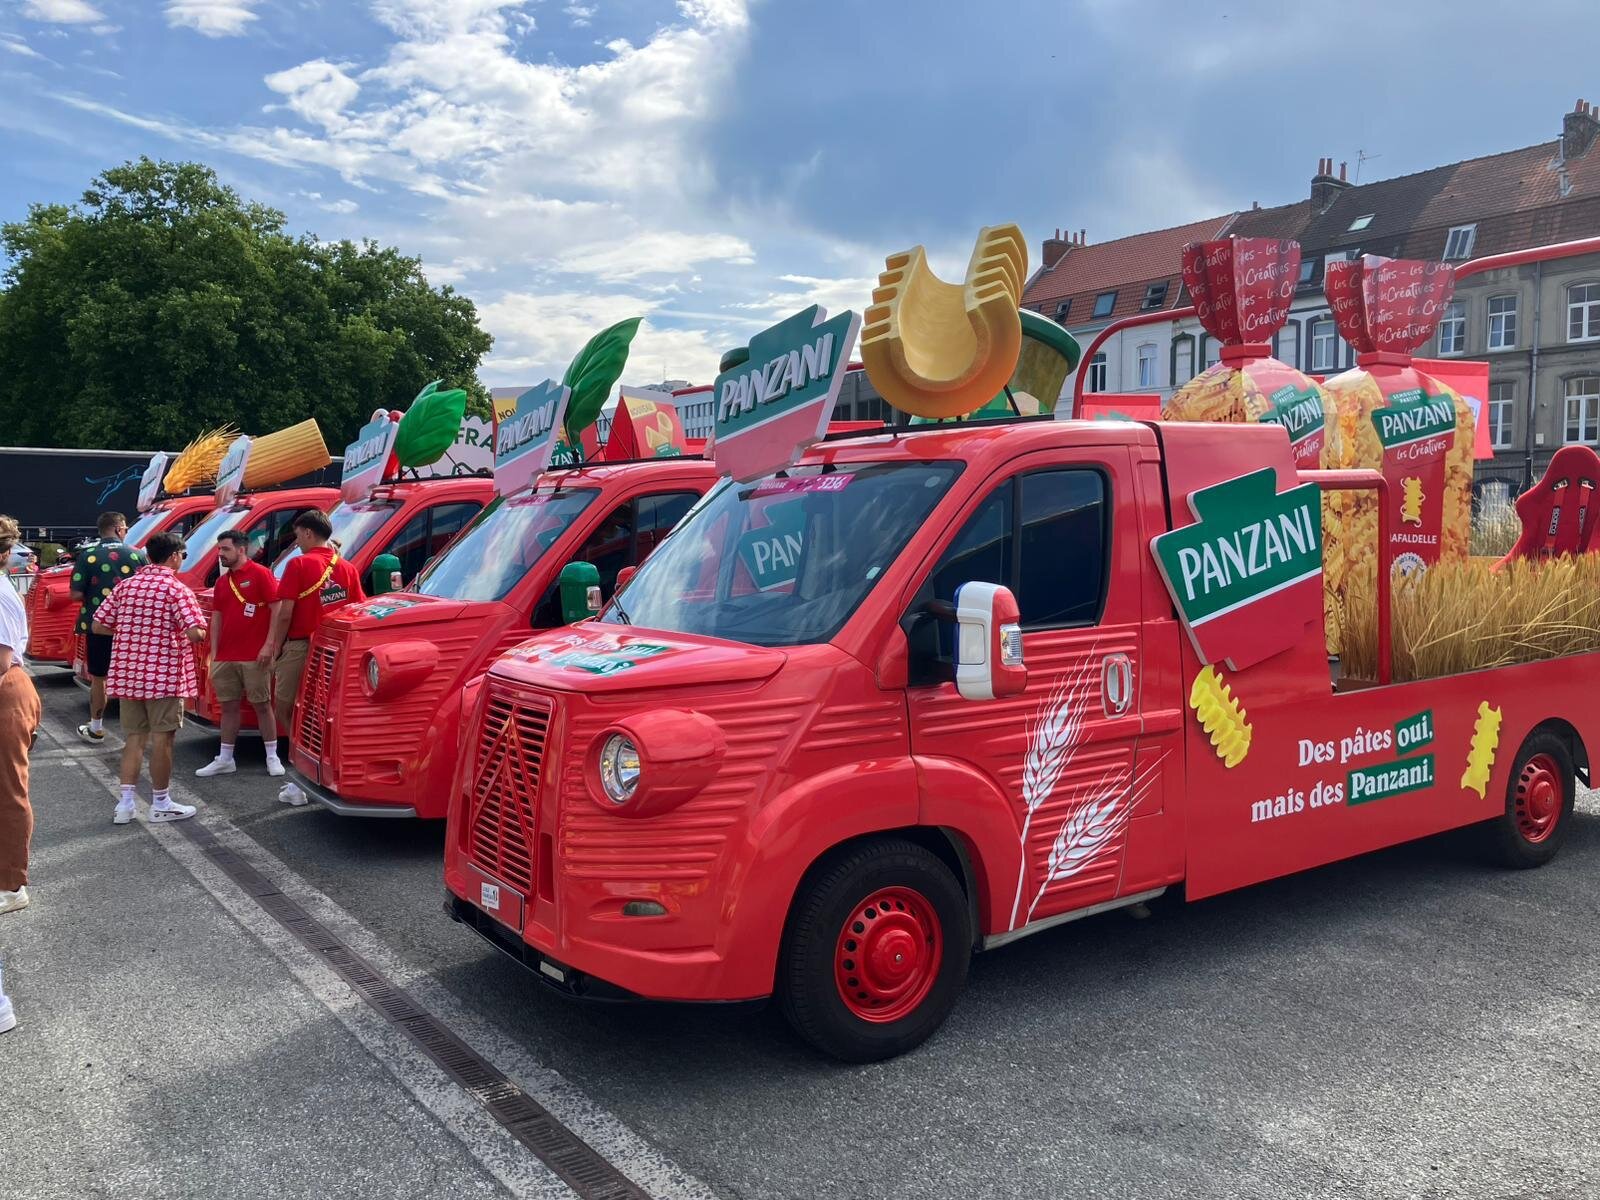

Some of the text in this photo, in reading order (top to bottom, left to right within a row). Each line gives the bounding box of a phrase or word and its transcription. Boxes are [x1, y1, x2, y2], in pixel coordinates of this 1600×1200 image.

[1245, 262, 1290, 286] Créatives
[1387, 280, 1435, 303] Créatives
[1384, 322, 1433, 344] Créatives
[717, 333, 833, 422] PANZANI
[496, 400, 555, 456] PANZANI
[1381, 401, 1453, 438] PANZANI
[1409, 439, 1447, 460] Créatives
[1177, 504, 1317, 601] PANZANI
[1298, 715, 1434, 767] Des pâtes oui,
[1251, 758, 1434, 823] mais des Panzani.
